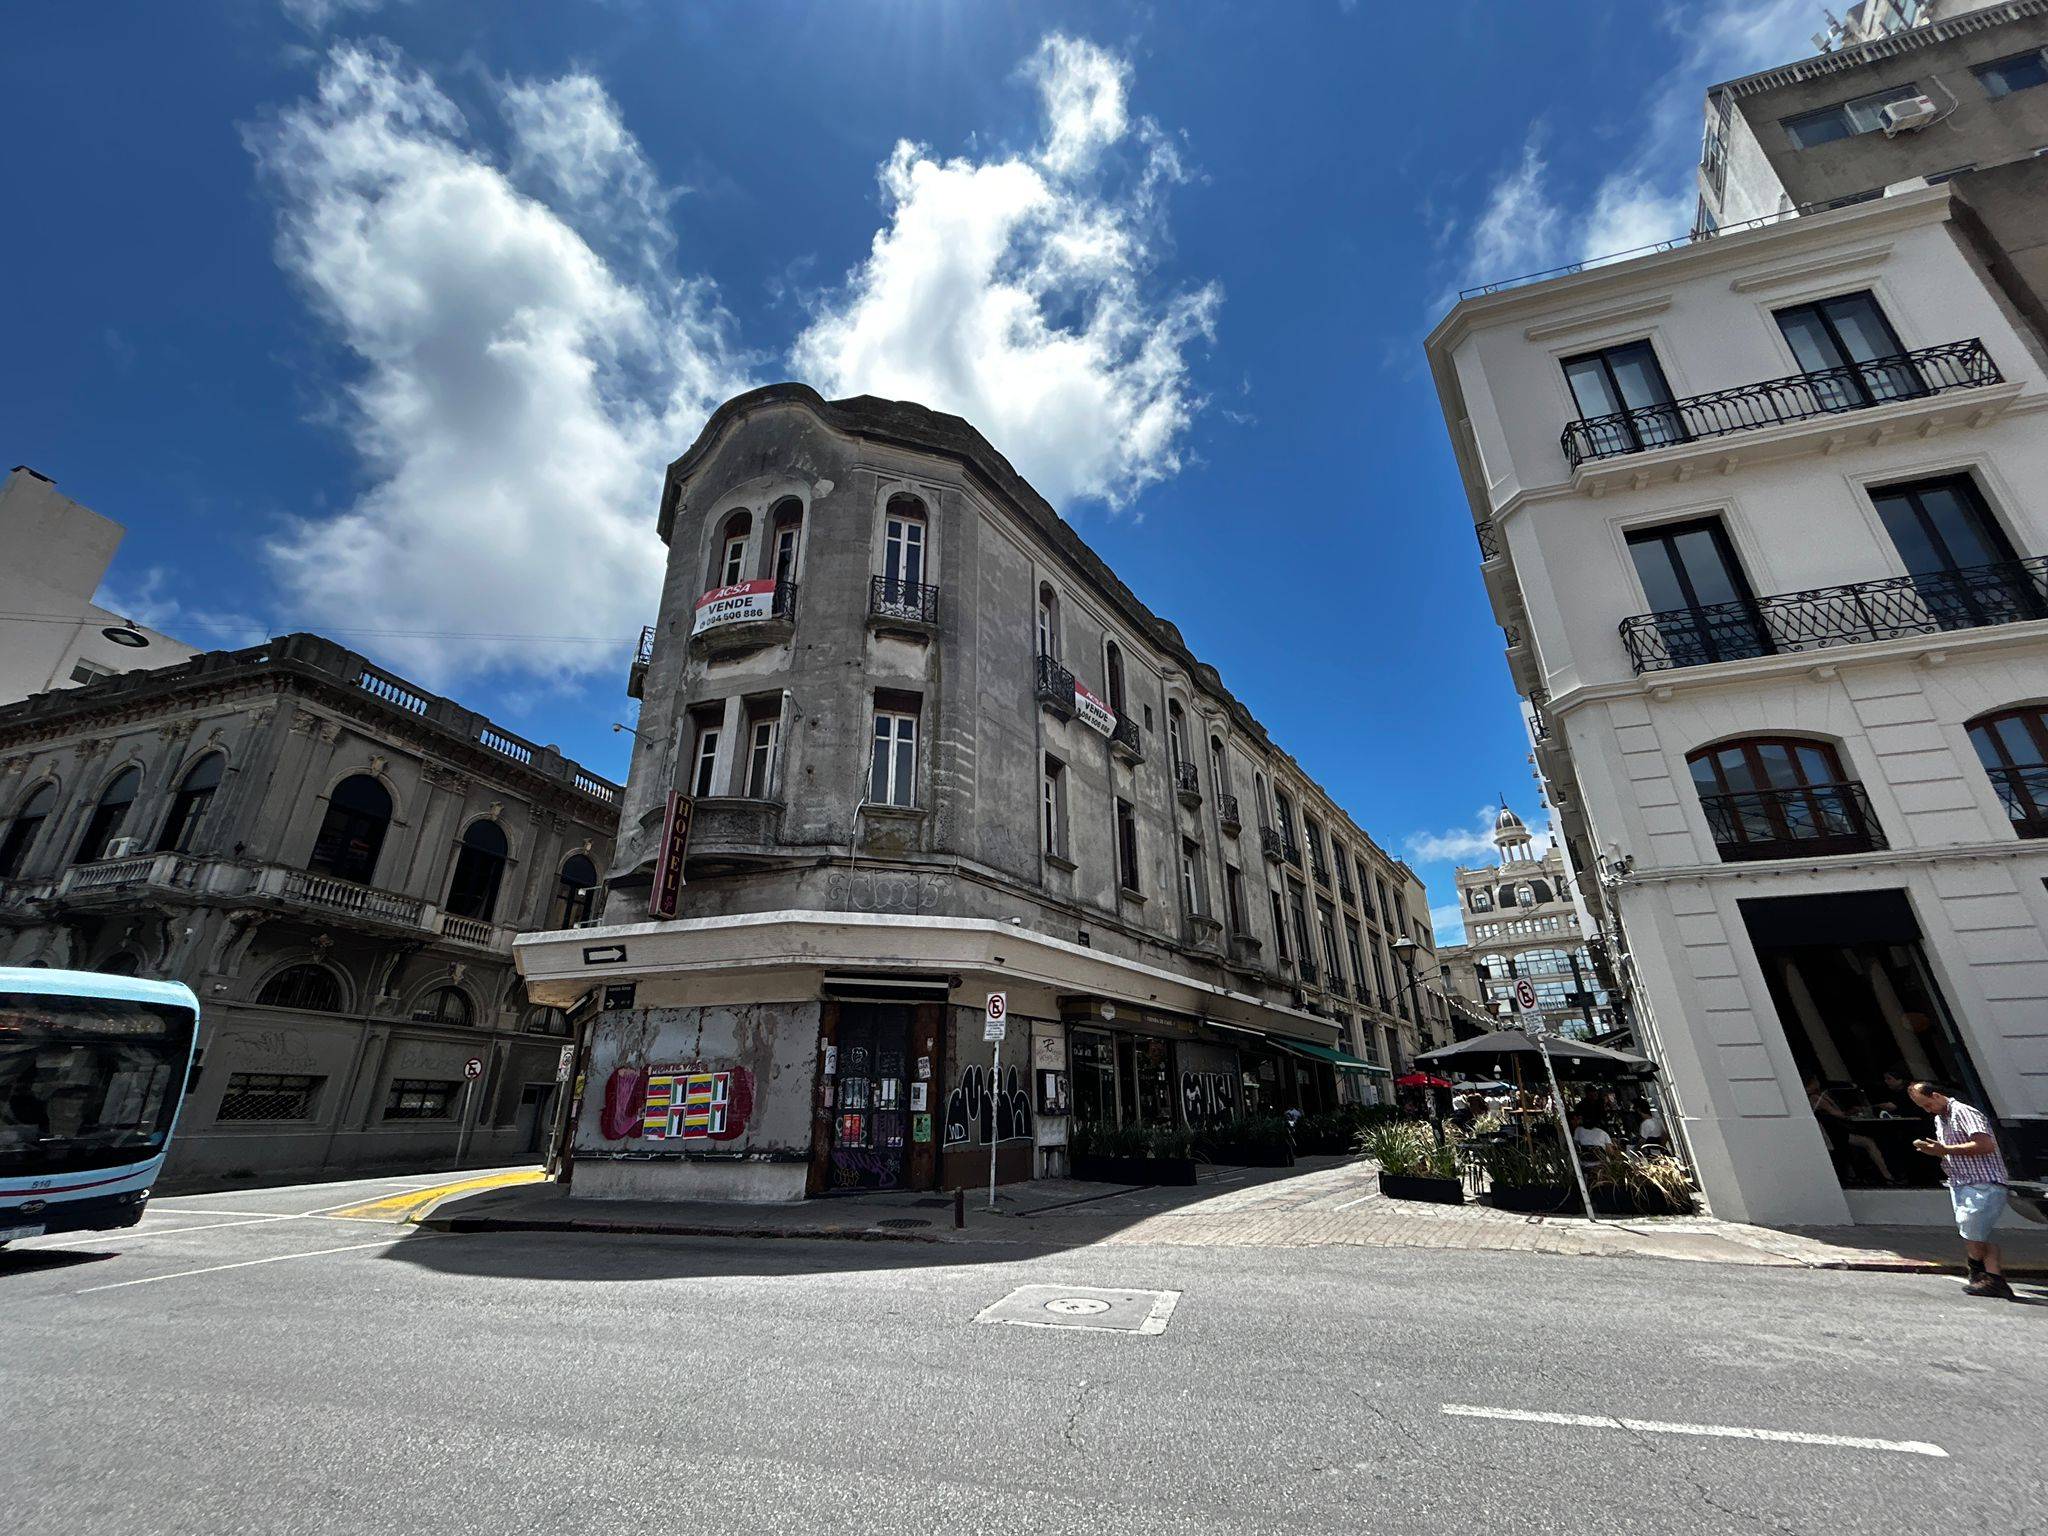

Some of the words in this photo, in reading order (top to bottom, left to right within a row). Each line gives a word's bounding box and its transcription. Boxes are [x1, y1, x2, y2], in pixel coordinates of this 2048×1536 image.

[714, 583, 751, 599] ACSA
[708, 597, 754, 615] VENDE
[743, 608, 763, 618] 886
[1085, 700, 1109, 722] VENDE
[667, 801, 689, 890] HOTEL
